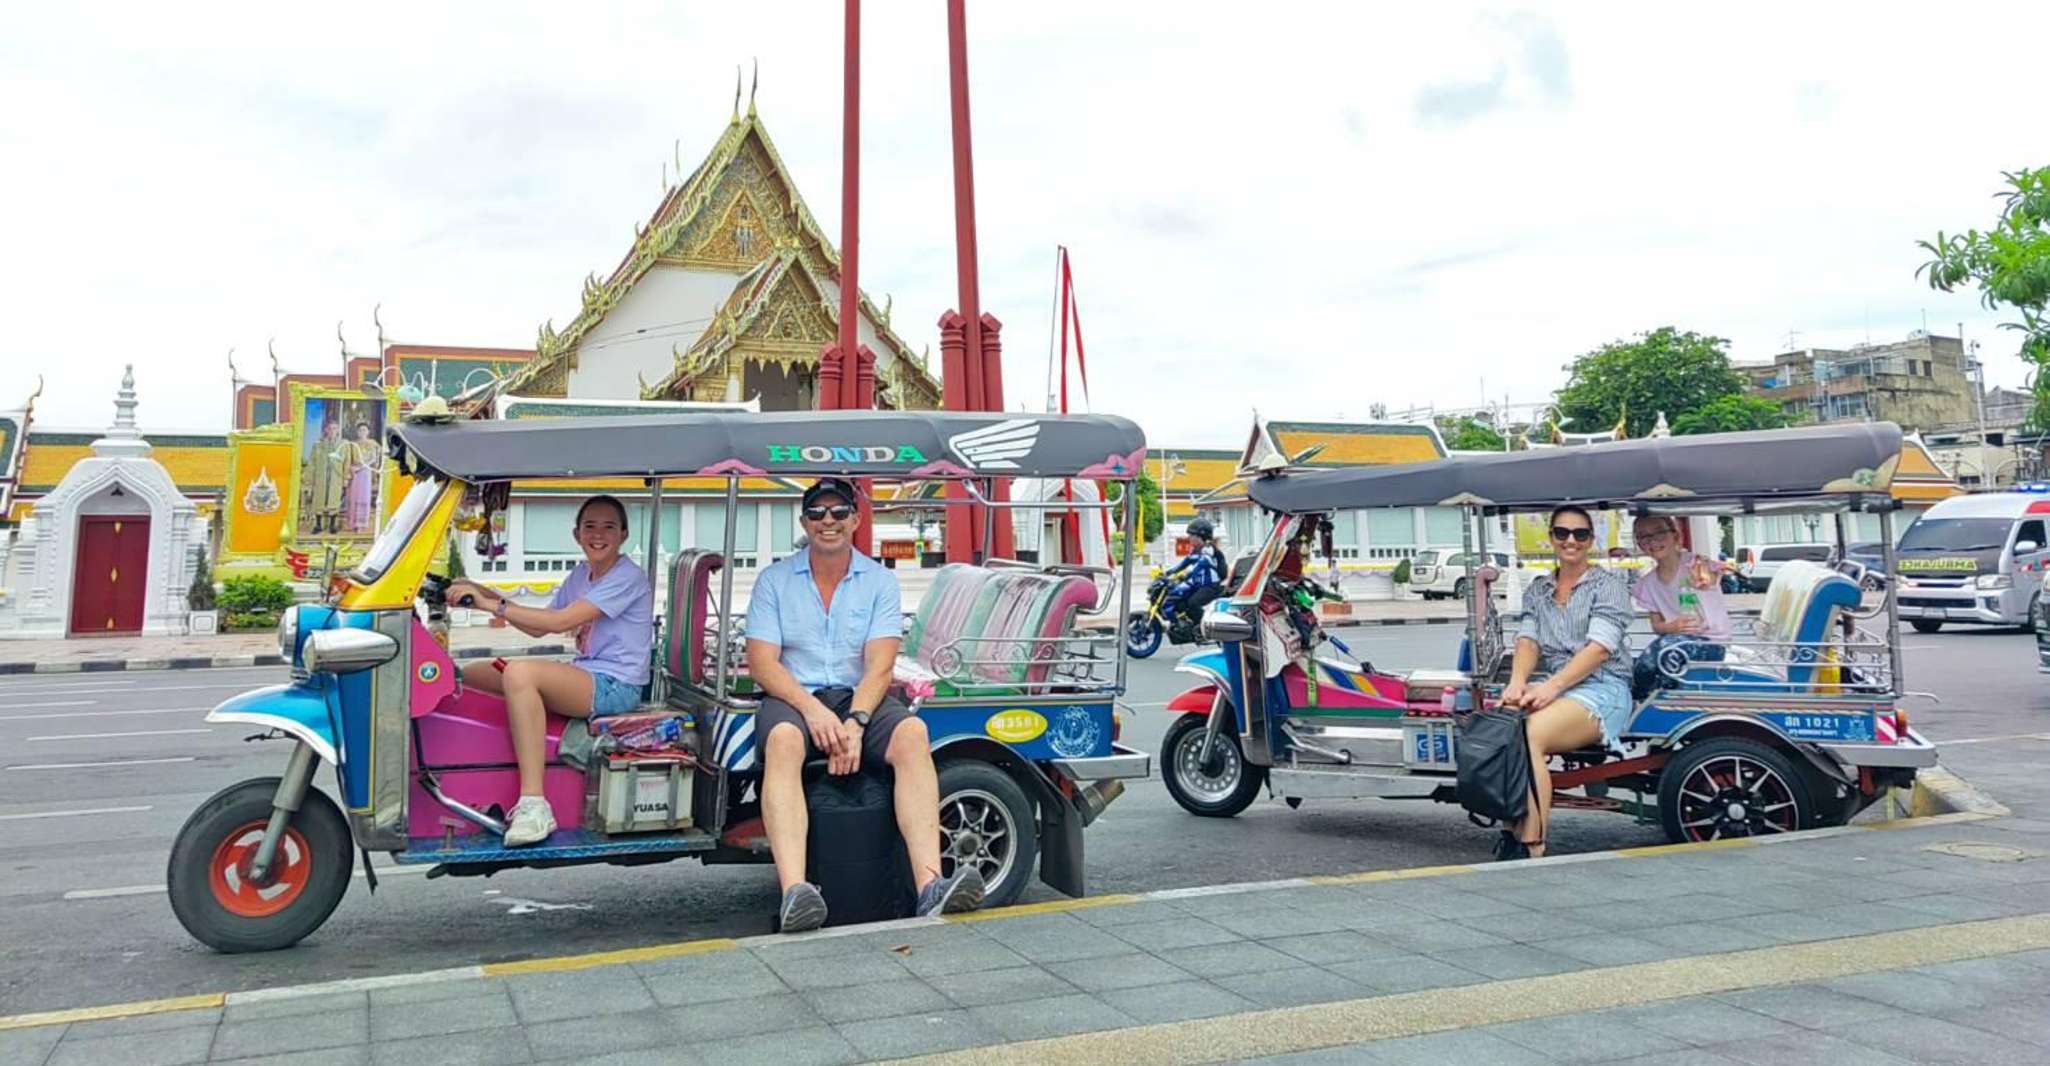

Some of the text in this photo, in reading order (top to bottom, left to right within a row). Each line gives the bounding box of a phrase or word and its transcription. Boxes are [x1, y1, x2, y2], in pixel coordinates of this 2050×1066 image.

[767, 445, 928, 463] HONDA
[1805, 717, 1839, 728] 1021
[633, 802, 669, 813] YUASA
